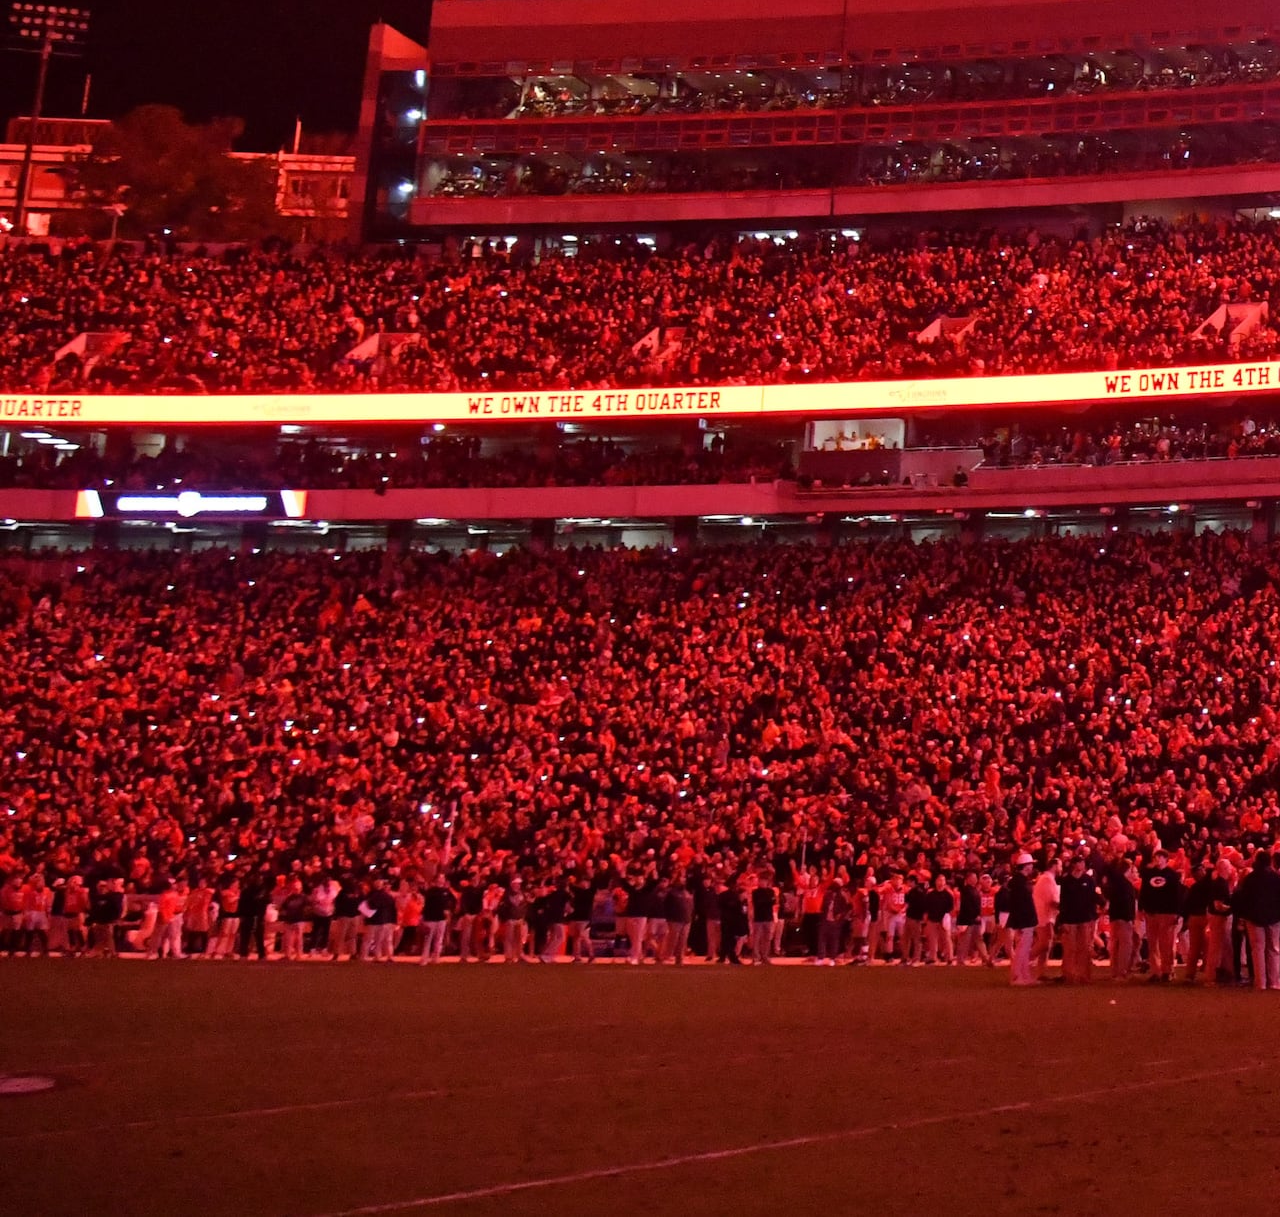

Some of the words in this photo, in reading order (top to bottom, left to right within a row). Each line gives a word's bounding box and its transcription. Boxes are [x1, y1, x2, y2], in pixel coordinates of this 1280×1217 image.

[1104, 374, 1131, 393] WE
[1139, 372, 1179, 392] OWN
[1187, 369, 1224, 389] THE
[1232, 367, 1271, 386] 4TH
[0, 399, 82, 417] UARTER
[468, 397, 494, 414] WE
[501, 396, 540, 414] OWN
[548, 395, 584, 413] THE
[592, 394, 629, 411] 4TH
[635, 391, 720, 412] QUARTER
